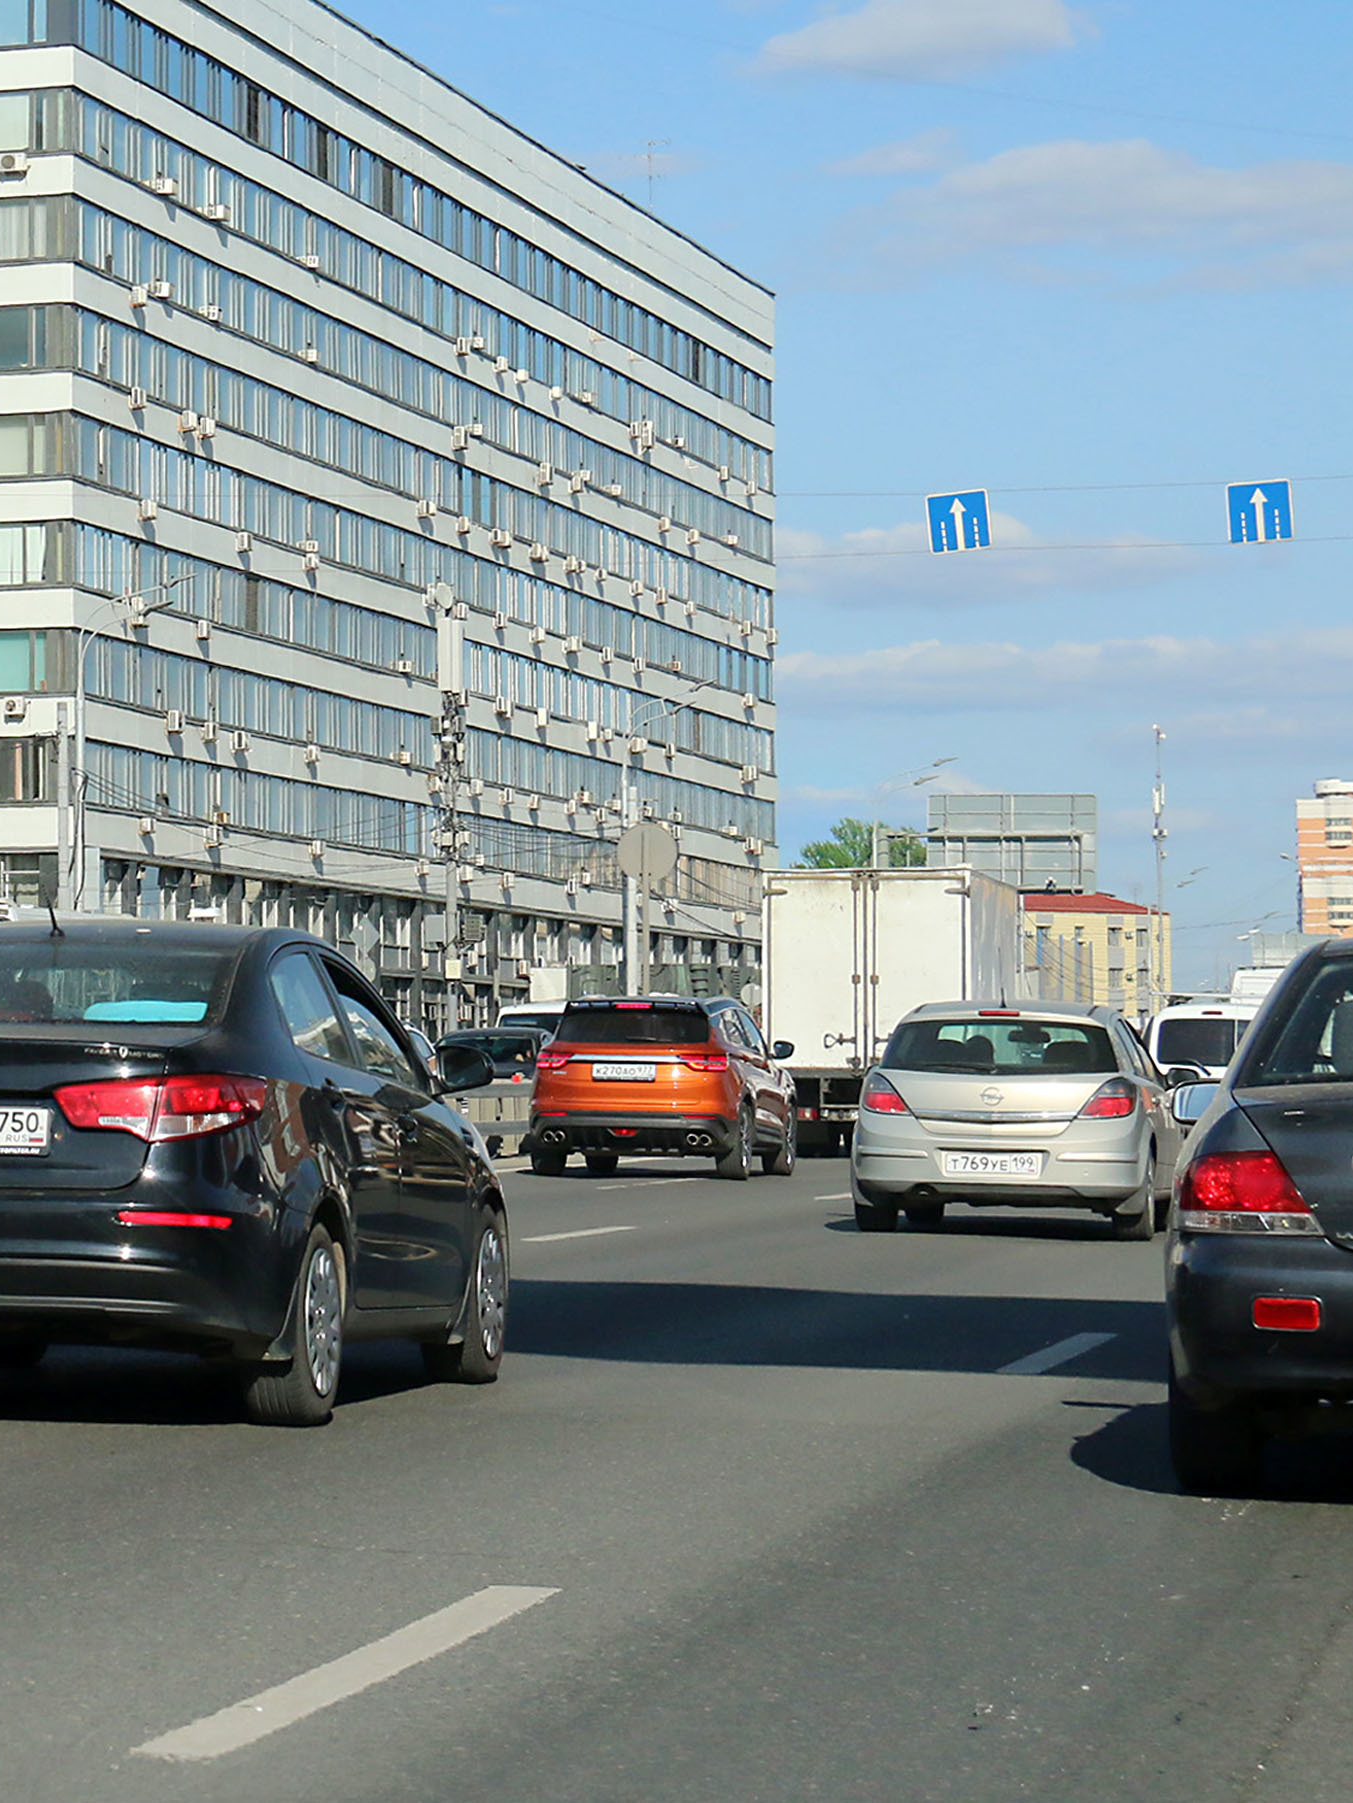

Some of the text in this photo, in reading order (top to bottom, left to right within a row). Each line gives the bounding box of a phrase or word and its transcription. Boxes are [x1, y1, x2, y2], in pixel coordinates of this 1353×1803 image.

[5, 1134, 28, 1143] RUS
[951, 1155, 1034, 1171] Т769УЕ 199
